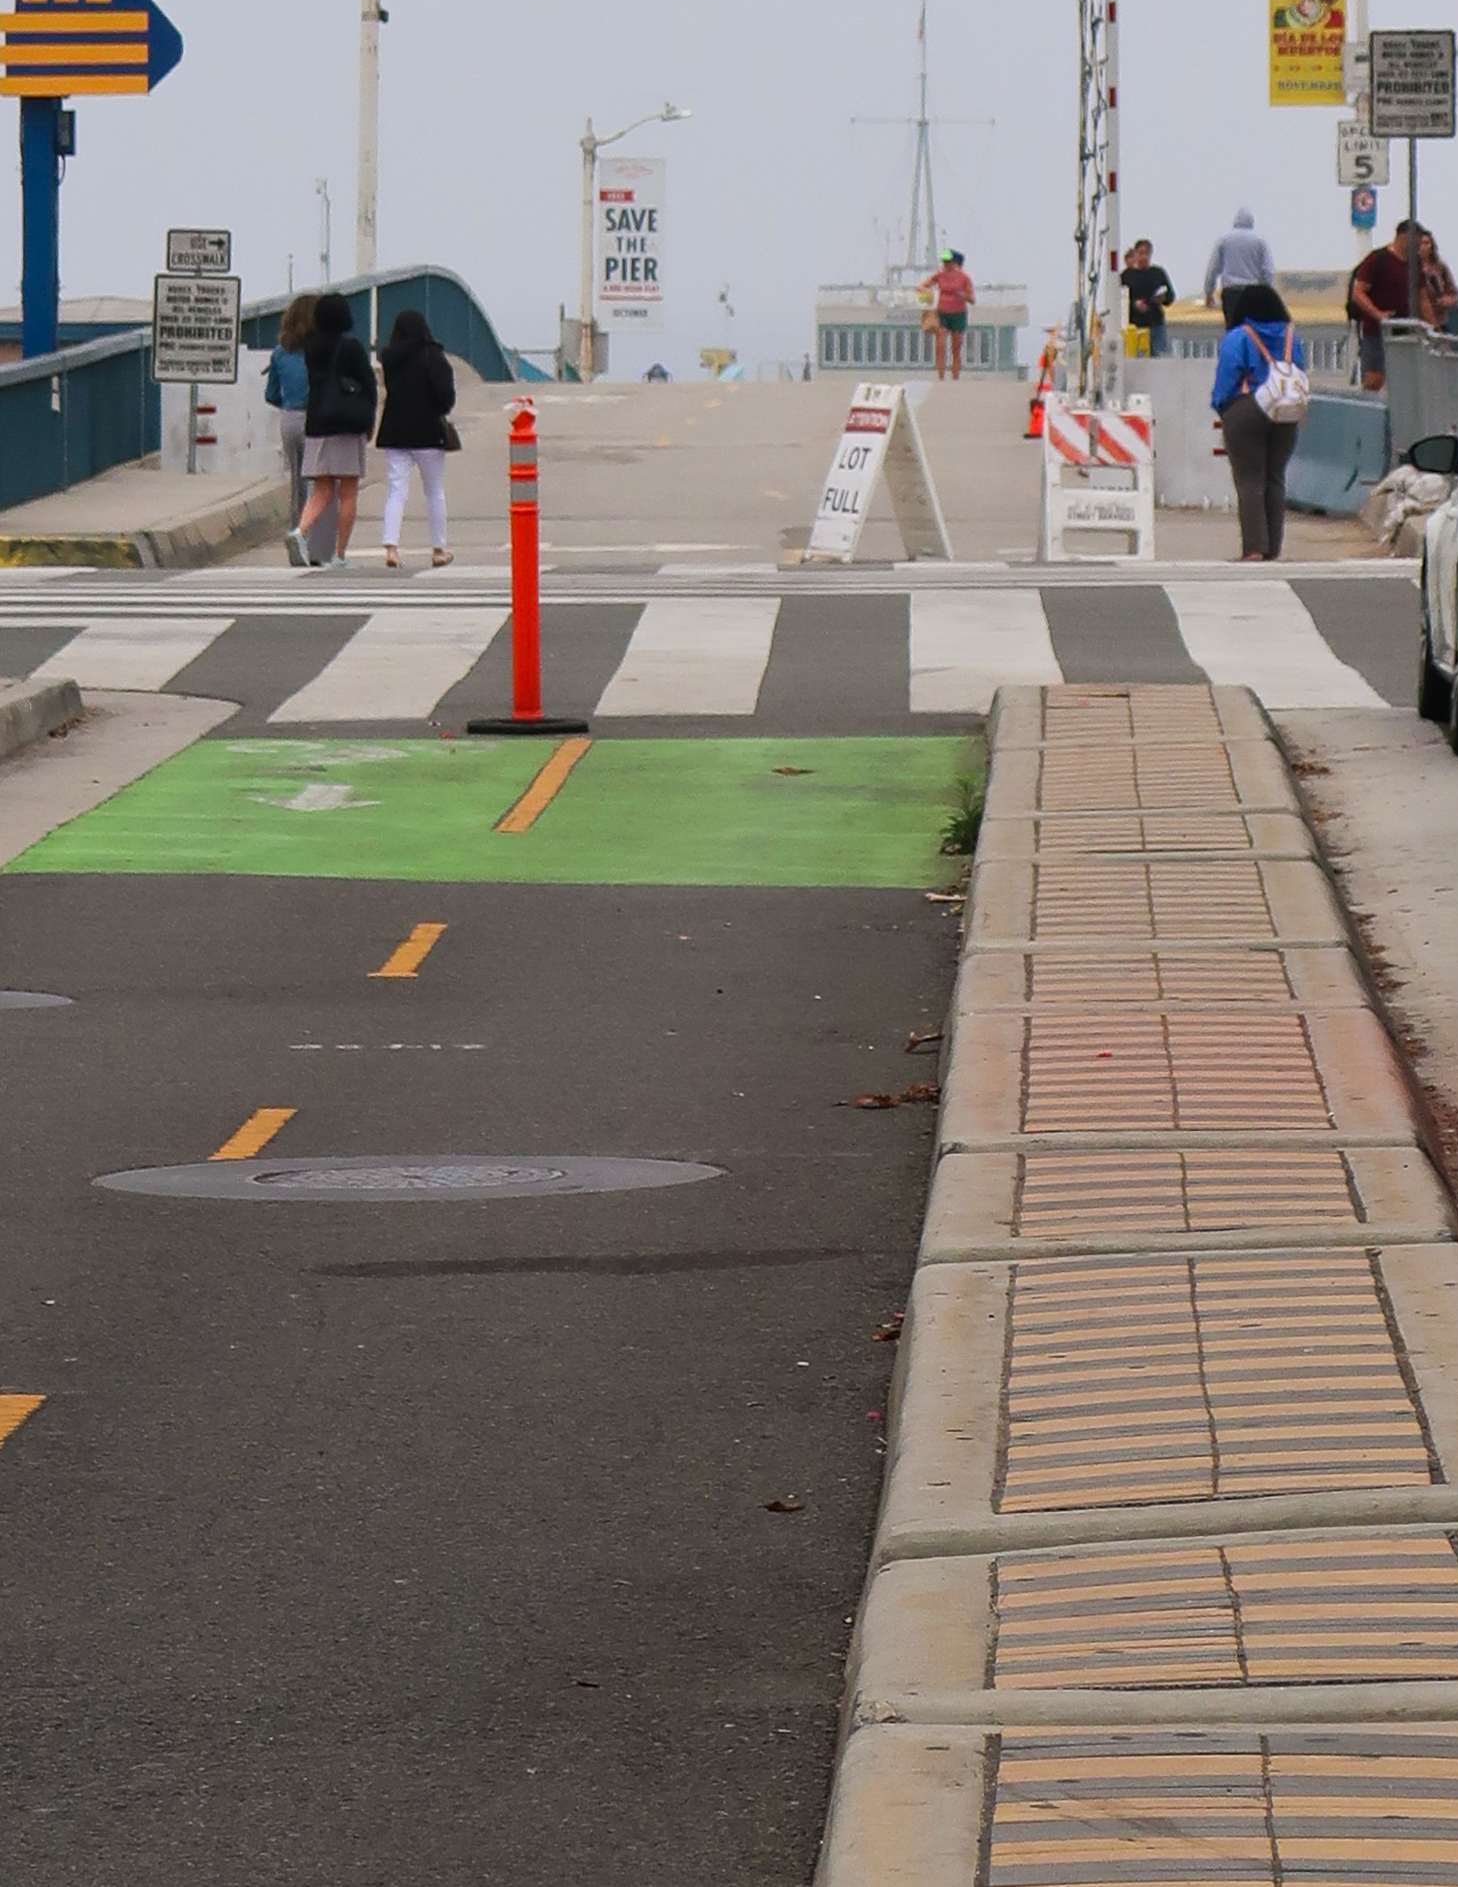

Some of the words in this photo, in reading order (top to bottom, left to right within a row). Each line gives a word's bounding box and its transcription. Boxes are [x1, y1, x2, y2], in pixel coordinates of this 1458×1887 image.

[1376, 81, 1450, 94] PROHIBITED
[1354, 154, 1375, 179] 5
[605, 208, 658, 233] SAVE
[616, 236, 648, 254] THE
[604, 257, 659, 282] PIER
[159, 325, 233, 341] PROHIBITED
[838, 446, 872, 470] LOT
[822, 487, 860, 514] FULL
